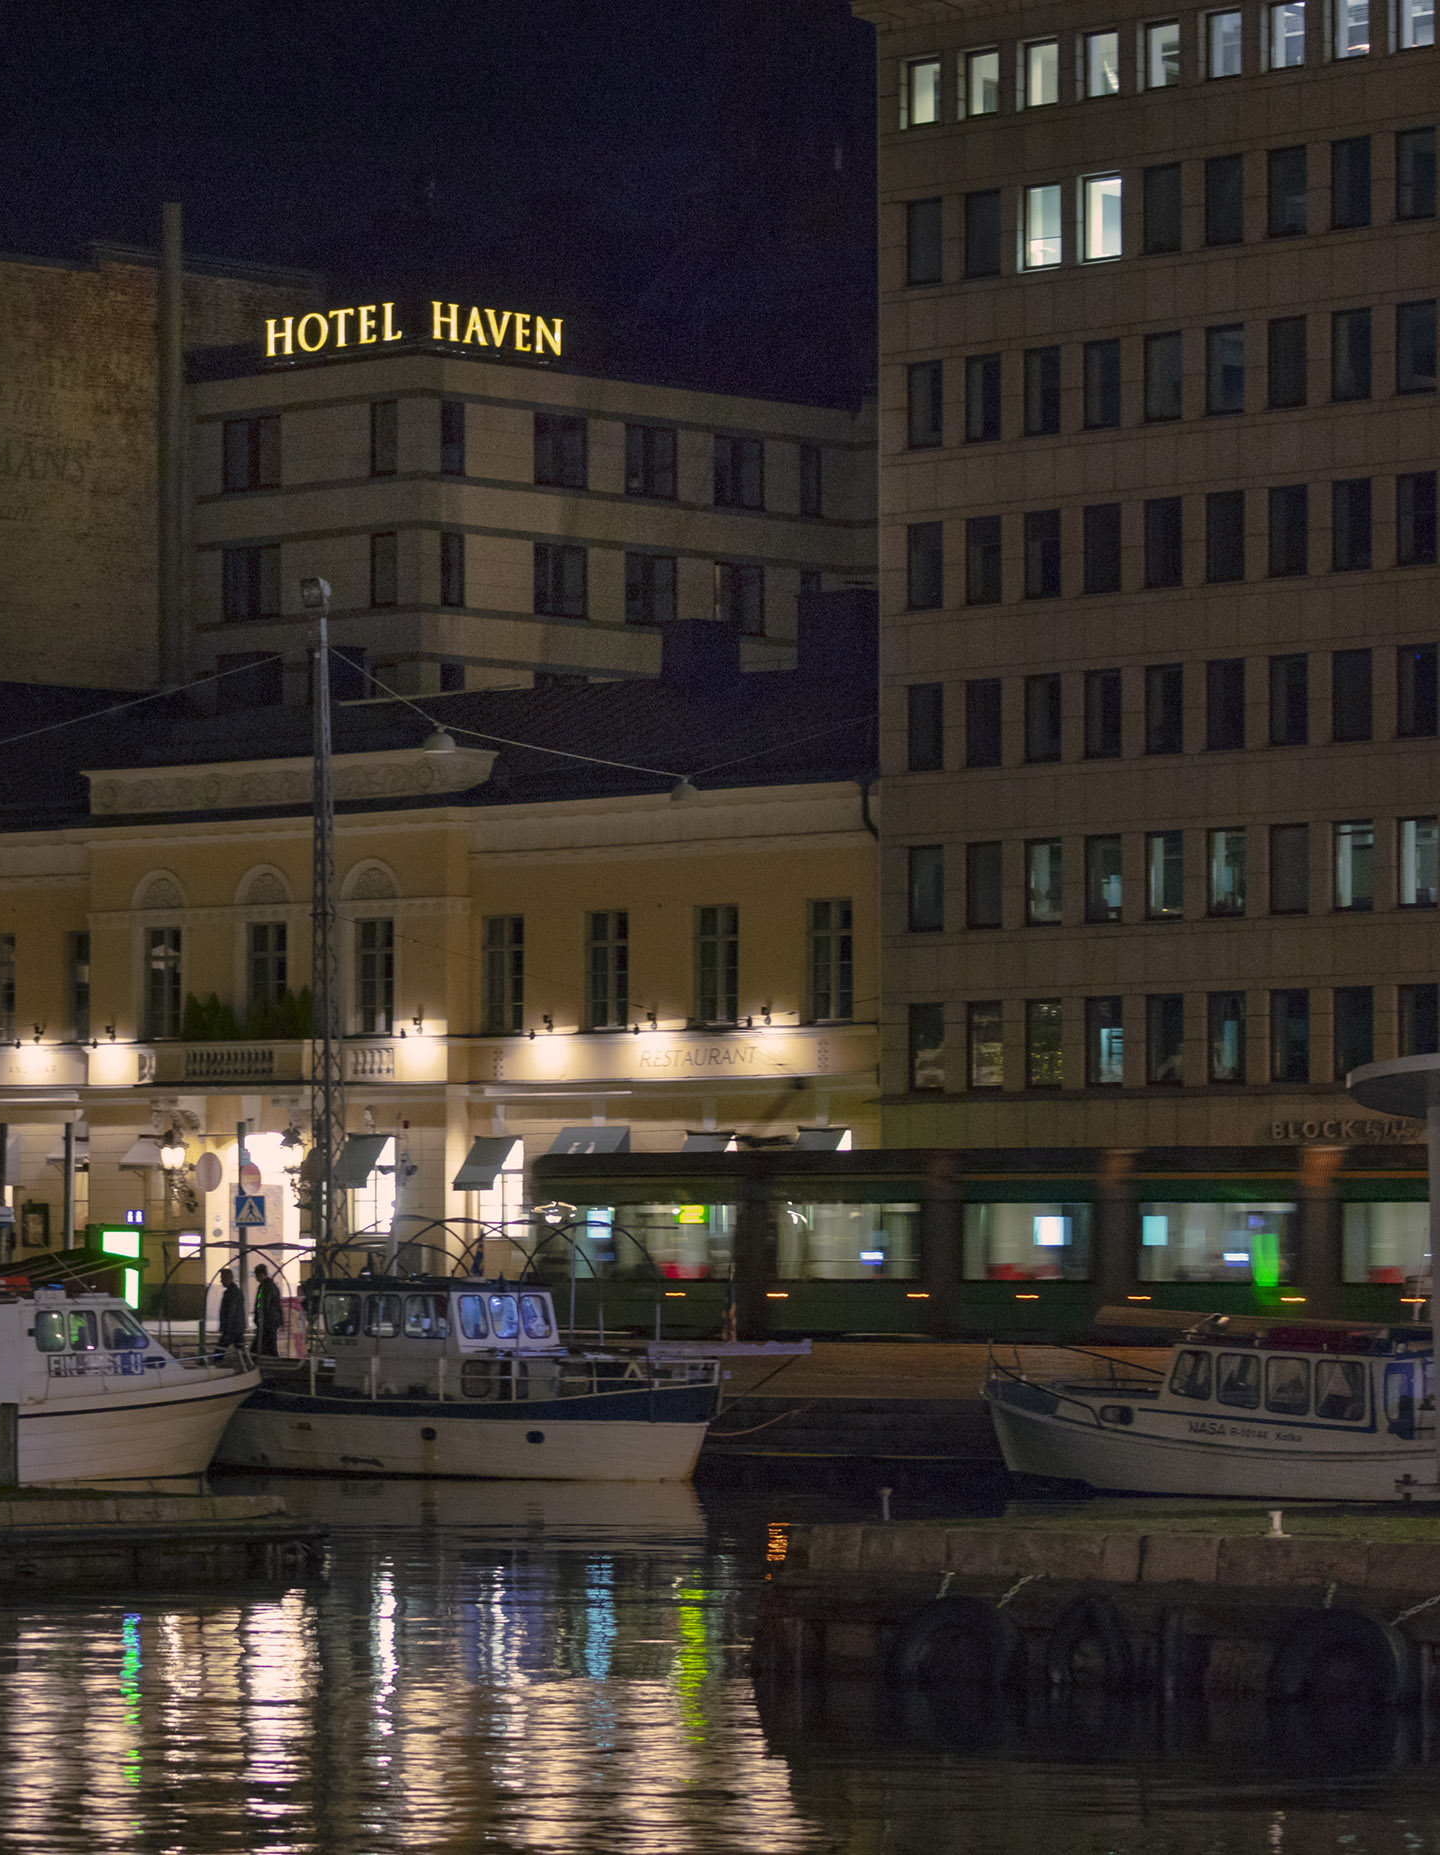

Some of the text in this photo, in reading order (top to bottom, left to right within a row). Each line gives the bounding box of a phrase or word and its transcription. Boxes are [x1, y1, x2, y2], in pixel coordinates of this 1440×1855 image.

[265, 301, 564, 357] HOTEL HAVEN
[640, 1046, 759, 1068] RESTAURANT
[1271, 1120, 1356, 1140] BLOCK
[1187, 1420, 1226, 1436] NASA
